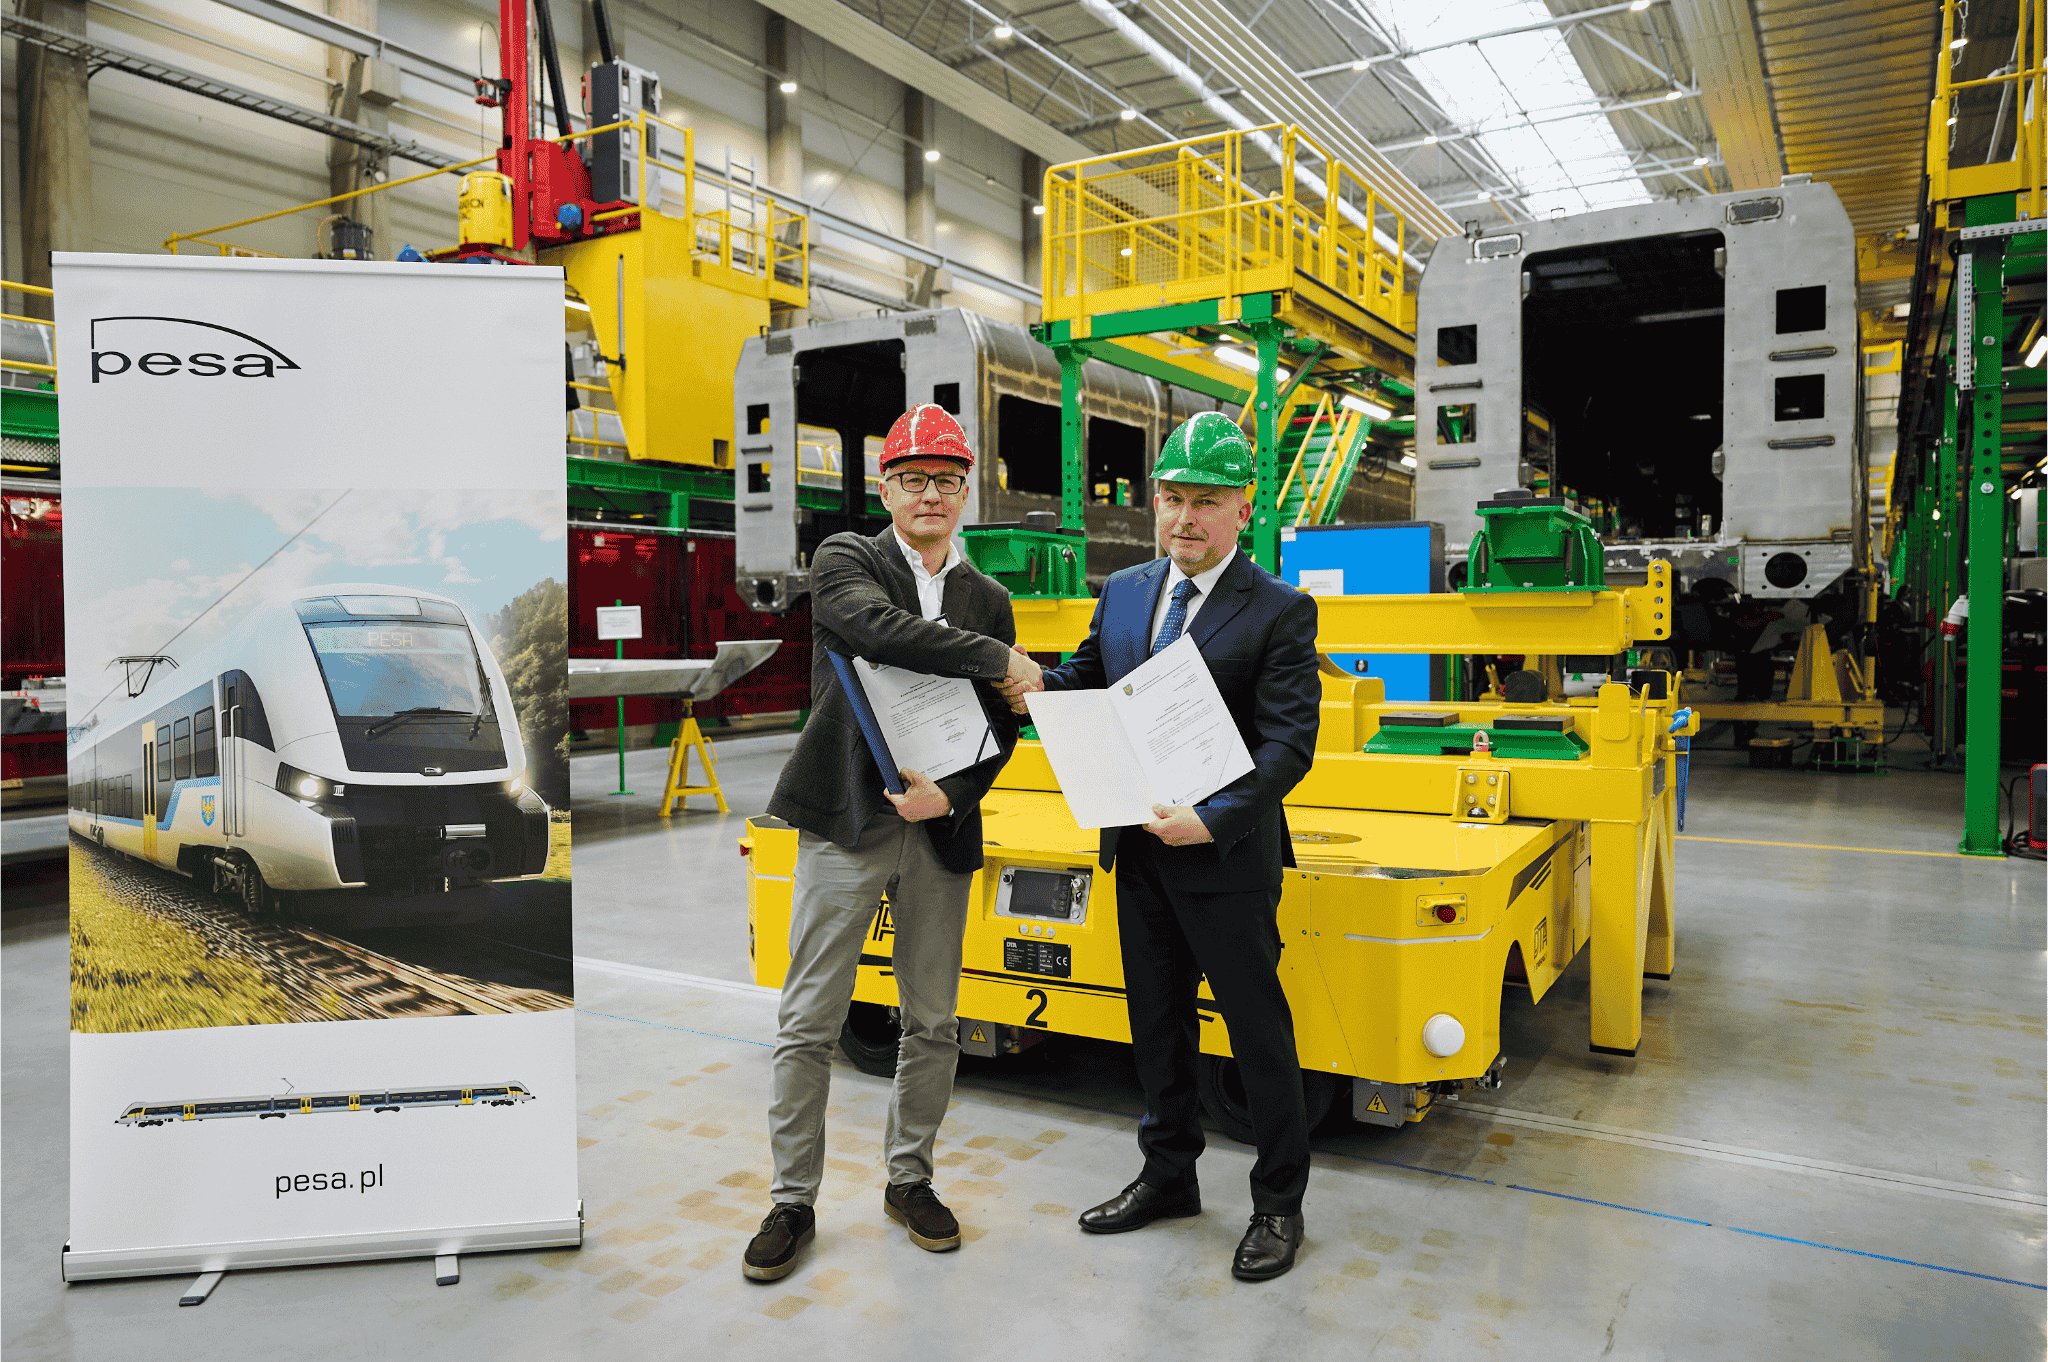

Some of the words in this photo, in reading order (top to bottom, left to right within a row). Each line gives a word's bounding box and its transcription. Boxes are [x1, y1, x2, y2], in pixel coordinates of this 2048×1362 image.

[91, 351, 275, 384] pesa
[368, 631, 413, 647] PESA
[1056, 956, 1068, 966] CE
[1025, 988, 1048, 1028] 2
[275, 1163, 383, 1200] pesa.pl
